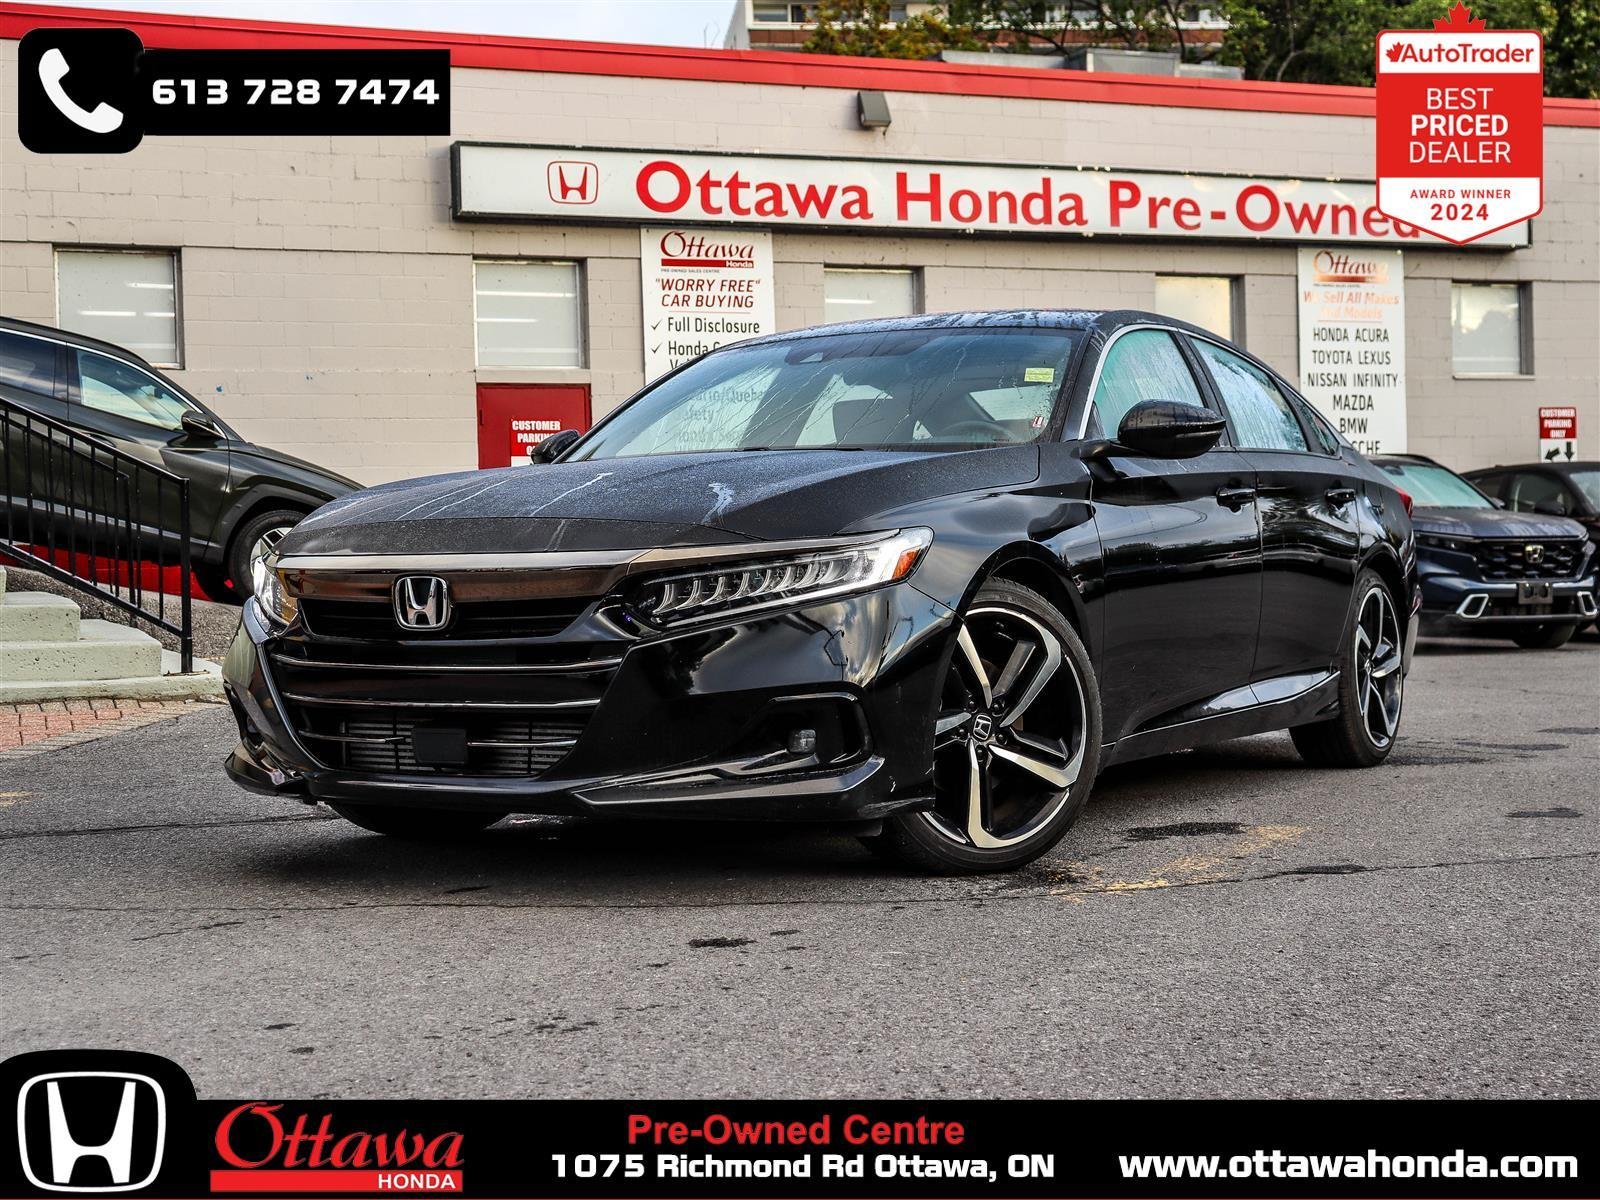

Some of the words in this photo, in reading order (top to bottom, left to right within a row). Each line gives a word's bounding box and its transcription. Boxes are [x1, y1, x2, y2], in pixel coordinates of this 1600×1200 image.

[636, 160, 874, 221] Ottawa
[896, 171, 1089, 226] Honda
[660, 230, 754, 259] Ottawa
[725, 260, 754, 269] Honda
[661, 294, 690, 307] CAR
[695, 294, 754, 308] BUYING
[668, 316, 690, 332] Full
[695, 317, 760, 333] Disclosure
[1313, 328, 1349, 342] HONDA
[1355, 328, 1390, 342] ACURA
[668, 340, 709, 356] Honda
[1312, 350, 1353, 364] TOYOTA
[1358, 351, 1391, 365] LEXUS
[1307, 373, 1347, 387] NISSAN
[1353, 373, 1399, 388] INFINITY
[1333, 395, 1374, 411] MAZDA
[1541, 409, 1575, 418] CUSTOMER
[512, 420, 561, 431] CUSTOMER
[1340, 417, 1368, 434] BMW
[517, 433, 555, 443] PARKIN
